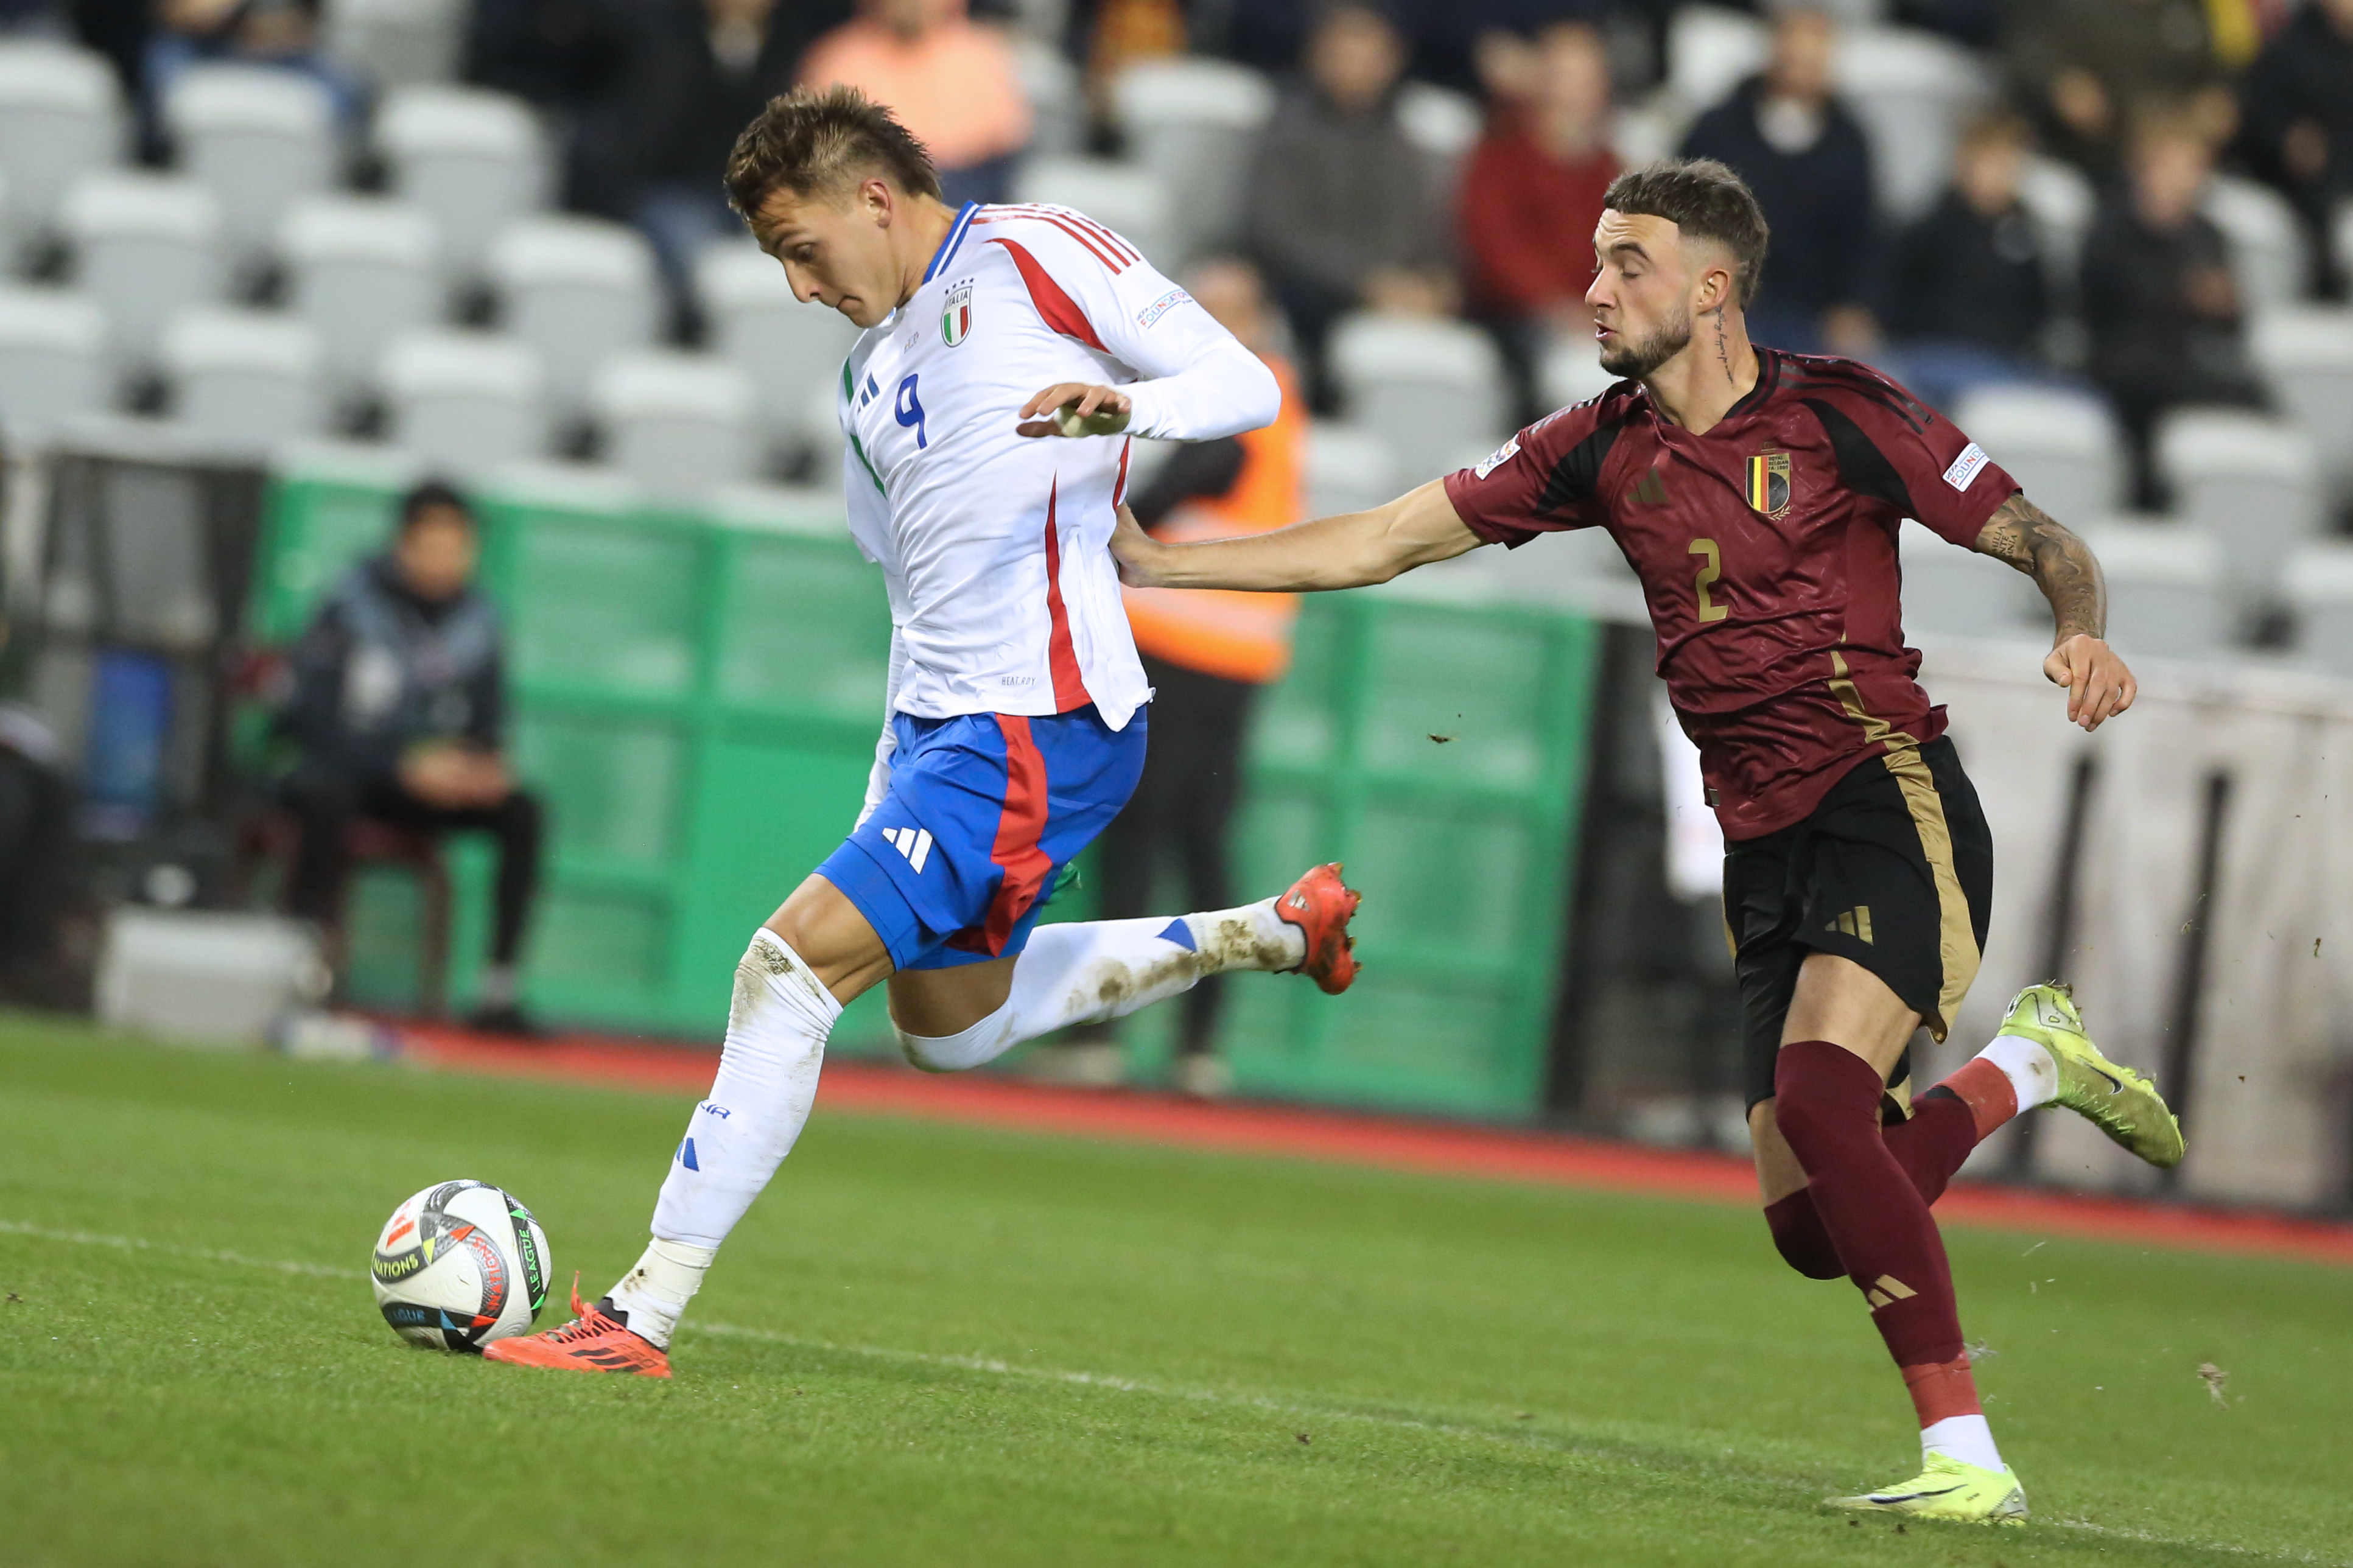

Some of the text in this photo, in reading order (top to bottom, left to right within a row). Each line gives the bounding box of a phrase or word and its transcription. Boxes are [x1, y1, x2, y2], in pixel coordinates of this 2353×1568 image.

[944, 290, 969, 312] ITALIA
[894, 373, 928, 450] 9
[1945, 464, 1959, 480] UEFA
[1688, 537, 1730, 623] 2
[373, 1253, 419, 1278] NATIONS
[472, 1236, 503, 1311] NATIONS
[517, 1228, 541, 1293] LEAGUE
